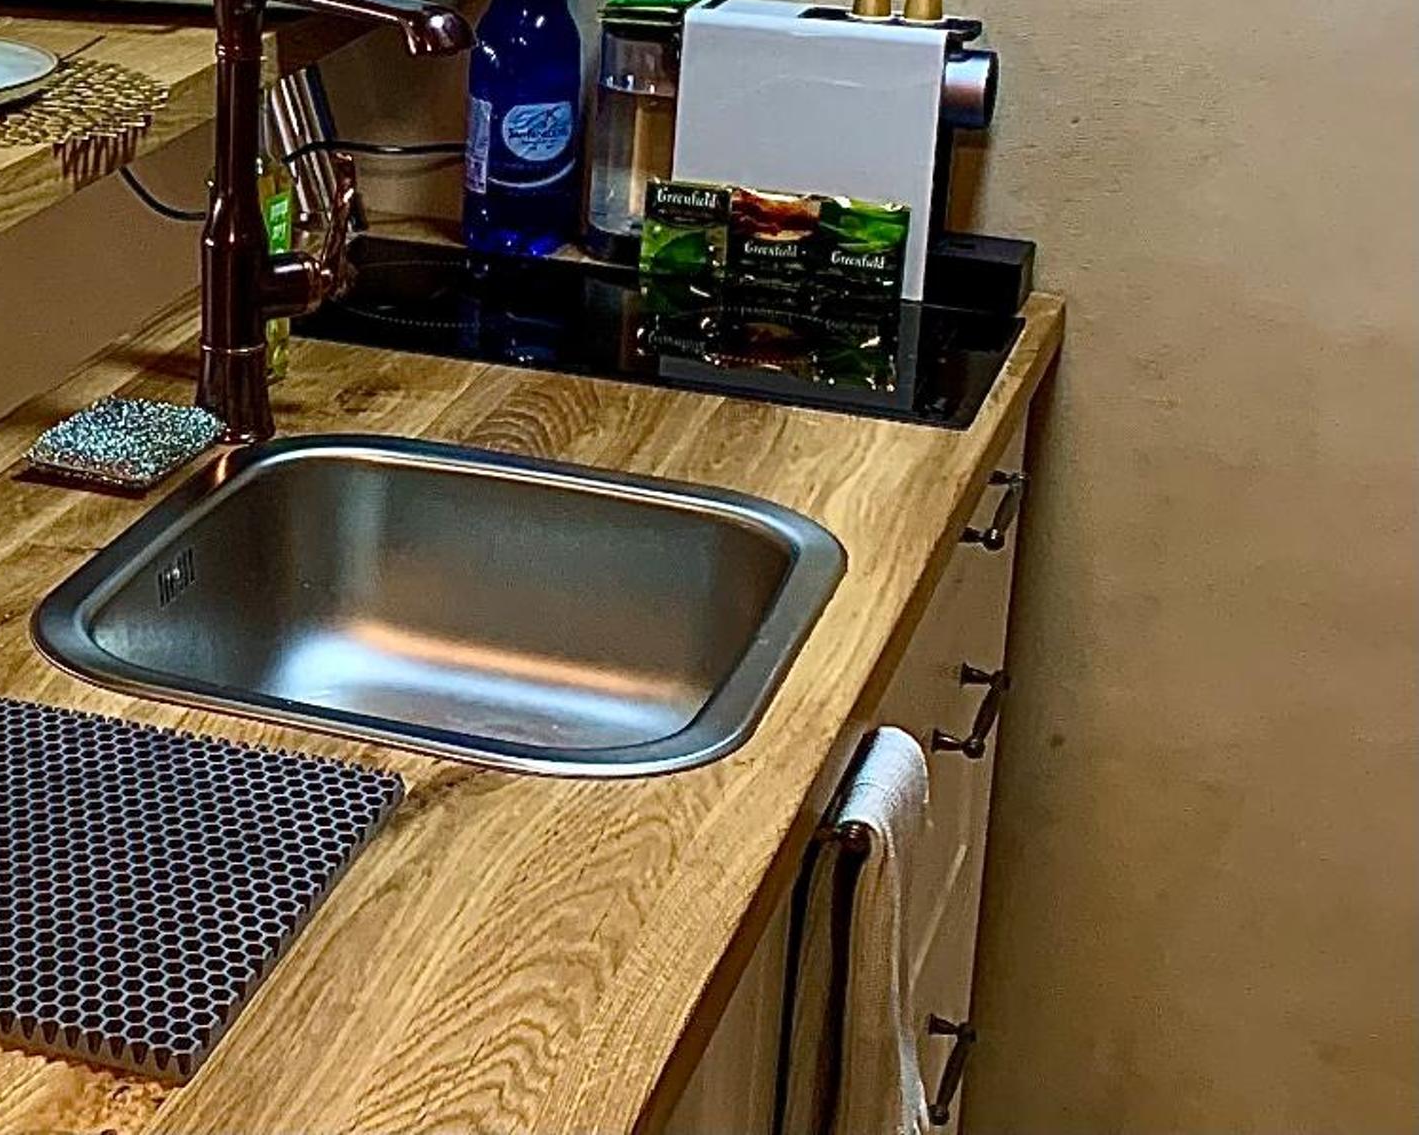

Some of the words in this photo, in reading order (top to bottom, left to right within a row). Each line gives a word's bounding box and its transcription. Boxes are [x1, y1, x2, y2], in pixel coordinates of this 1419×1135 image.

[657, 186, 717, 209] Greenfield
[744, 240, 798, 258] Greenfield
[830, 250, 885, 270] Greenfield
